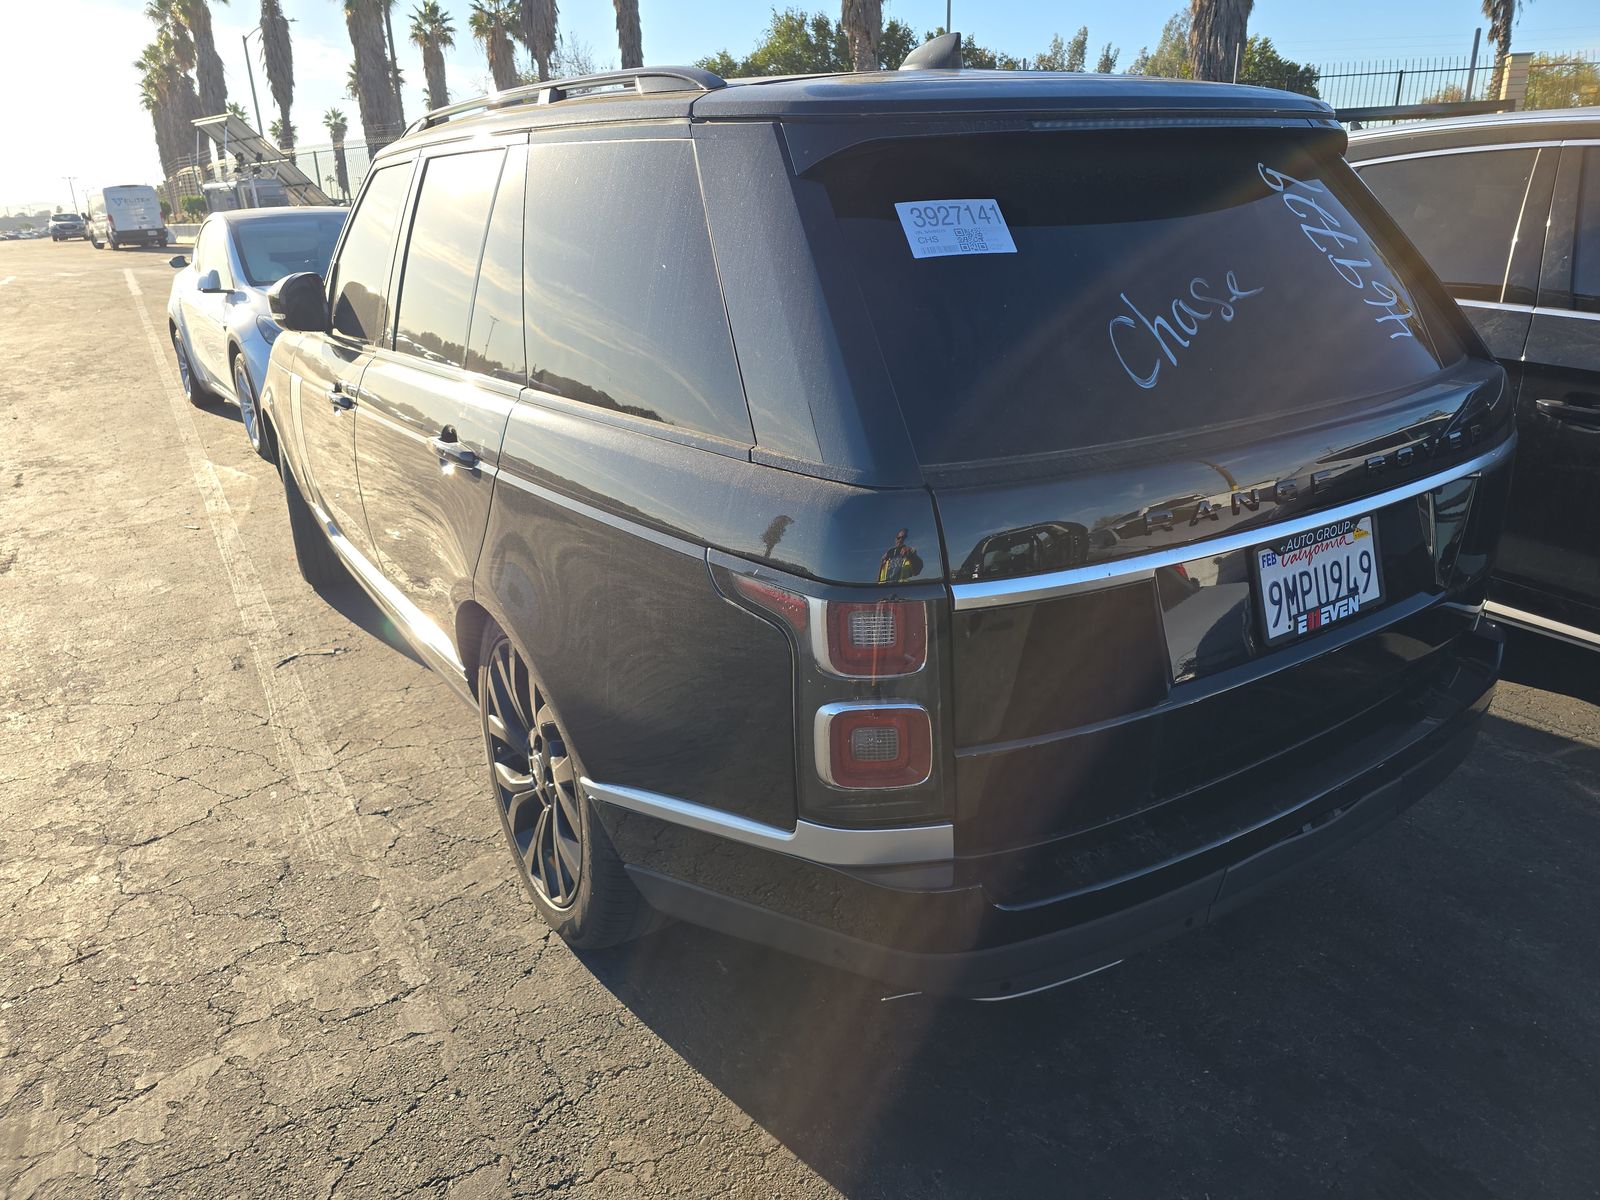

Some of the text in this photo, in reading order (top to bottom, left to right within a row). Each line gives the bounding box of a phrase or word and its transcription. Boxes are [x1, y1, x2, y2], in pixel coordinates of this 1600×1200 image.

[910, 204, 1002, 228] 3927141
[917, 235, 939, 244] CHS
[1110, 270, 1264, 389] Chase
[1144, 468, 1333, 536] RANGE
[1281, 534, 1354, 568] California
[1286, 533, 1314, 552] AUTO
[1316, 521, 1350, 541] GROUP
[1261, 552, 1277, 569] FEB
[1268, 550, 1372, 629] 9MPU949
